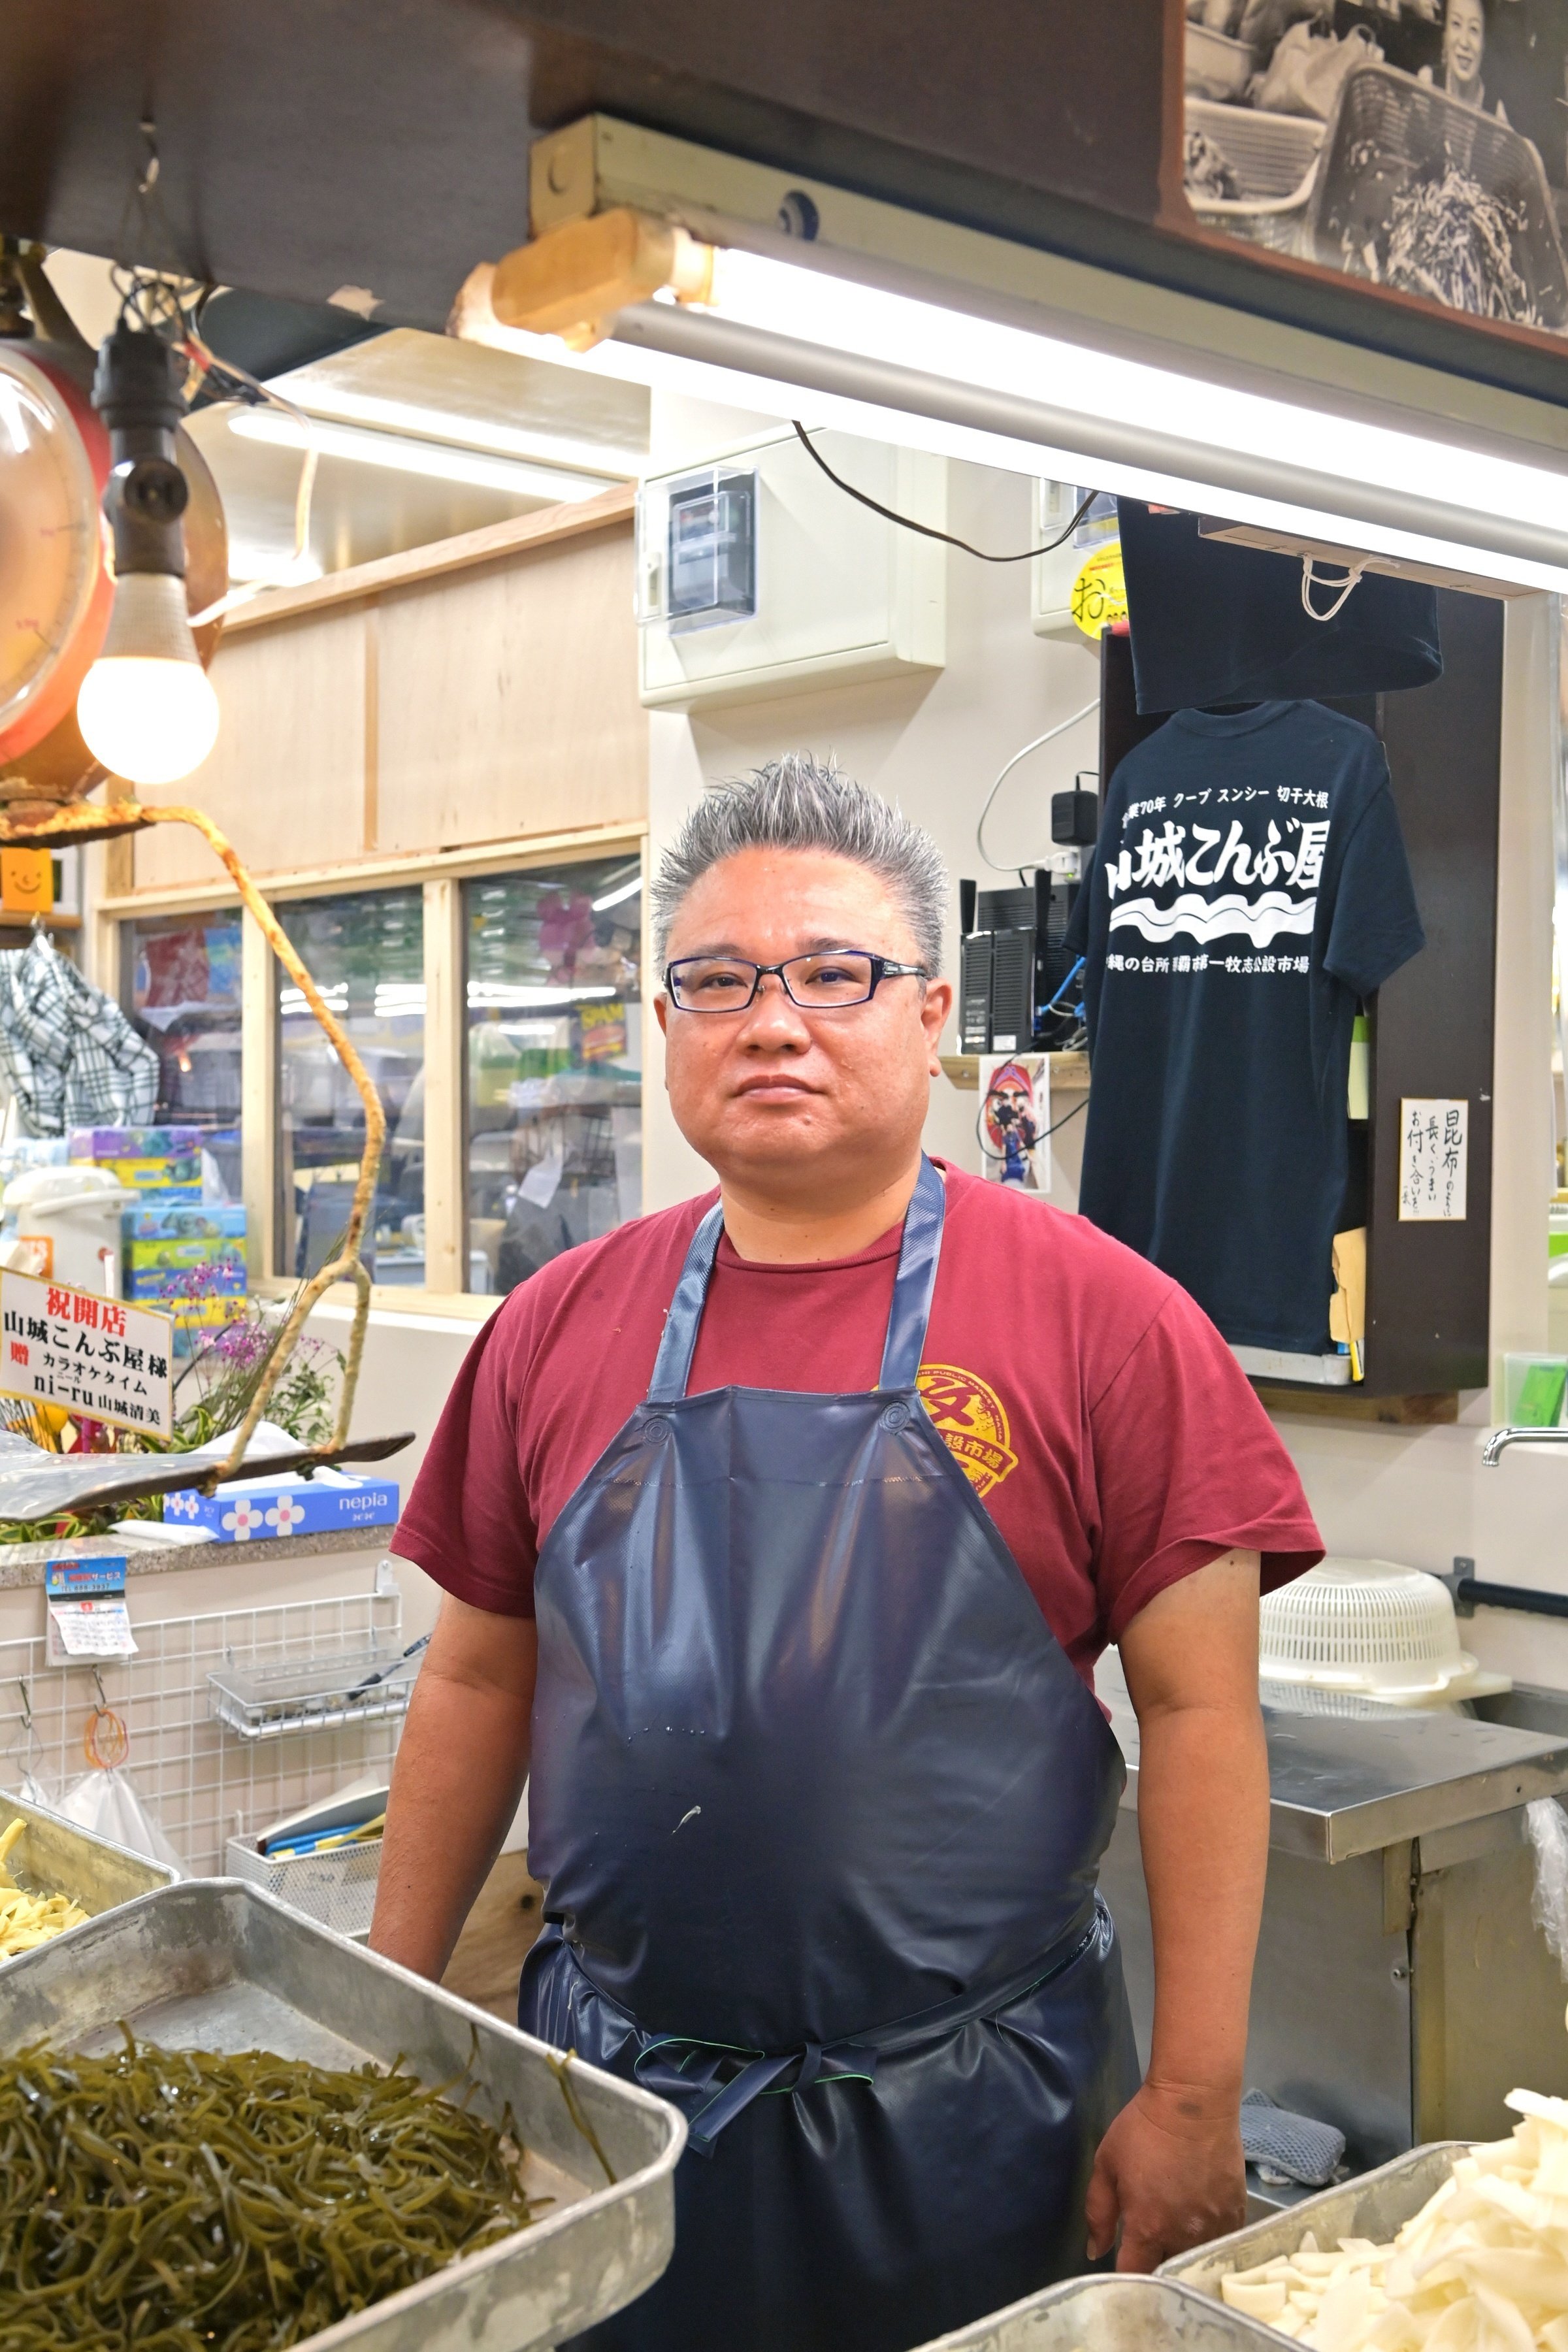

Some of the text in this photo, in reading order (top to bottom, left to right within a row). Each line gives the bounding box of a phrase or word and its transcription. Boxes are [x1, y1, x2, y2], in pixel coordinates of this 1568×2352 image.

[1173, 788, 1212, 808] クーブ
[1217, 786, 1269, 803] スンシー
[1277, 785, 1329, 809] 切干大根
[46, 1287, 127, 1337] 祝開店
[4, 1311, 168, 1379] 山城こんぶ屋様
[10, 1341, 29, 1367] 贈
[43, 1352, 148, 1396] カラオケタイム
[933, 1370, 966, 1382] PUBLIC
[968, 1380, 996, 1409] MARKET
[99, 1395, 161, 1426] 山城清美
[339, 1492, 387, 1511] nepia
